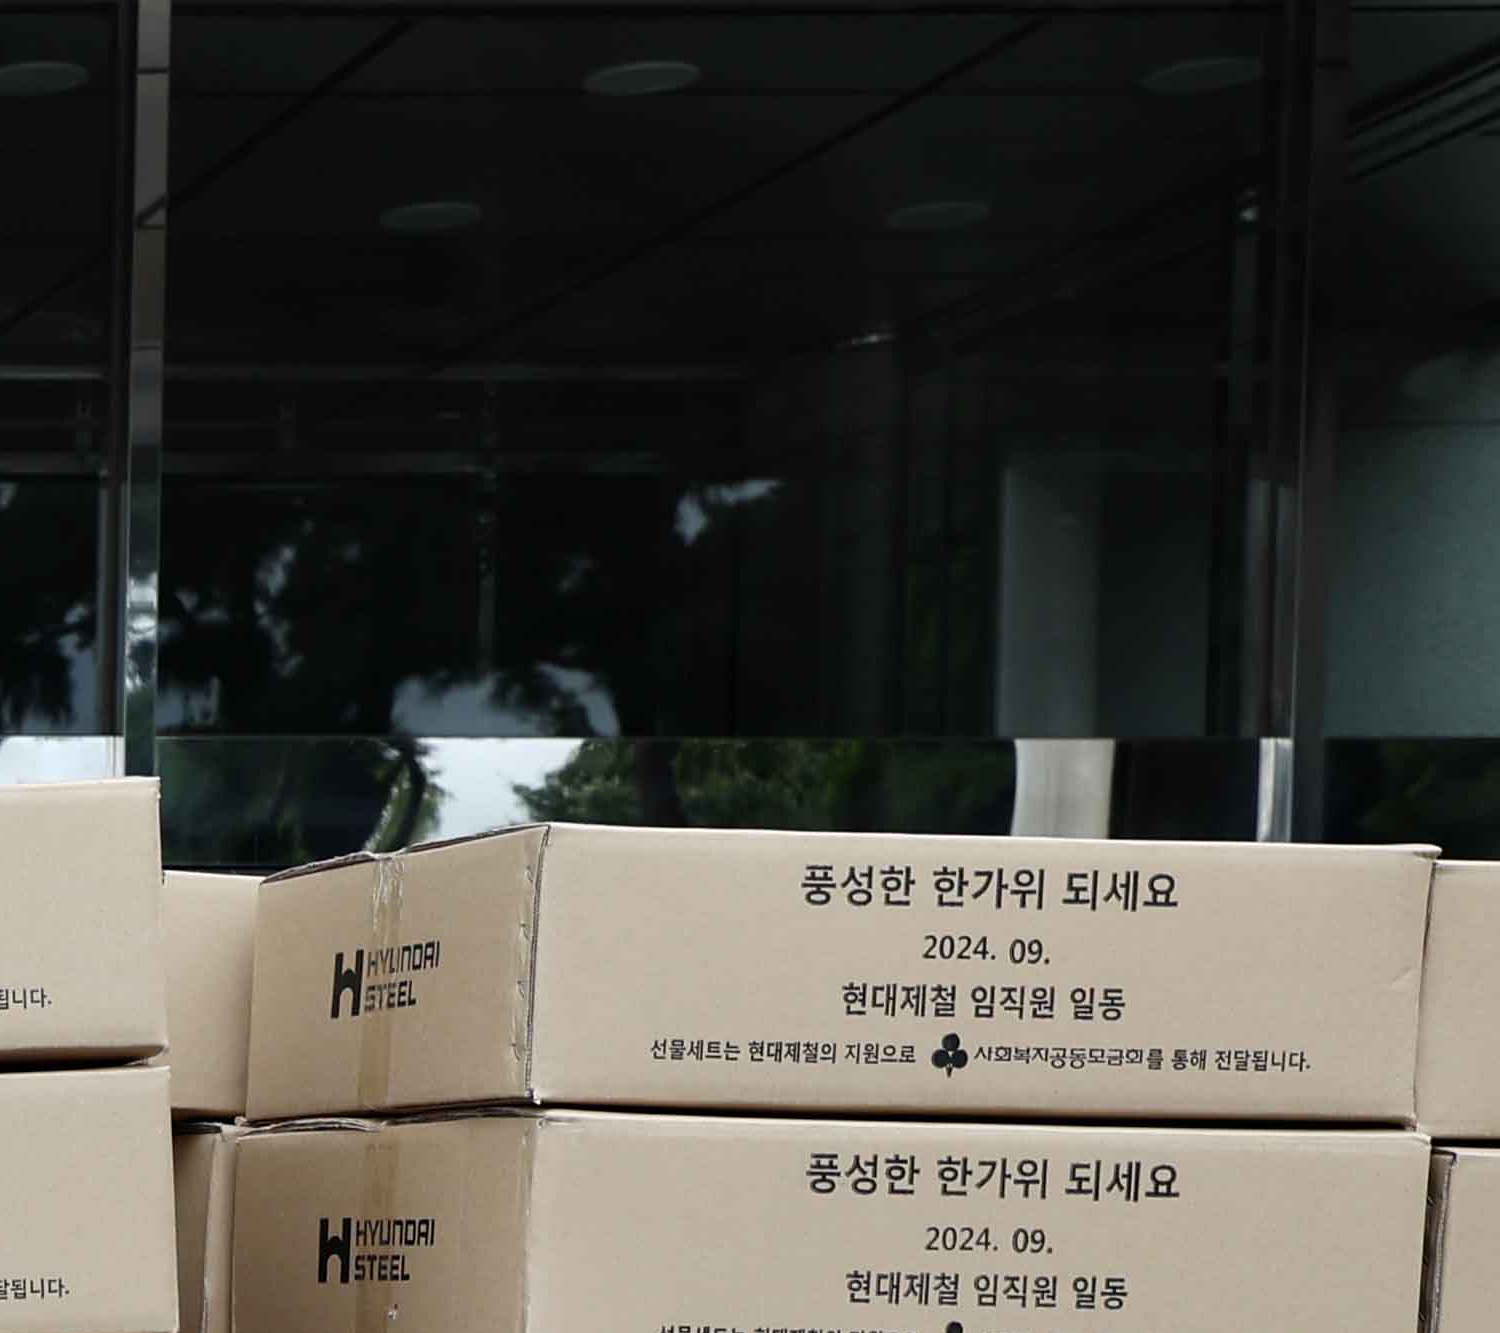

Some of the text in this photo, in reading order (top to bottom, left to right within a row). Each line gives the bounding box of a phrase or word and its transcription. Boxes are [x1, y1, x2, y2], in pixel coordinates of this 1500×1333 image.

[800, 864, 1179, 913] 풍성한 한가위 되세요
[921, 934, 1051, 966] 2024. 09.
[841, 981, 1127, 1022] 현대제철 임직원 일동
[650, 1038, 741, 1062] 선물세트는
[747, 1040, 837, 1065] 현대제철의
[844, 1042, 917, 1065] 지원으로
[1171, 1048, 1208, 1071] 통해
[1214, 1049, 1311, 1073] 전달됩니다.
[355, 1217, 436, 1249] HYUNDAI
[353, 1253, 411, 1283] STEEL
